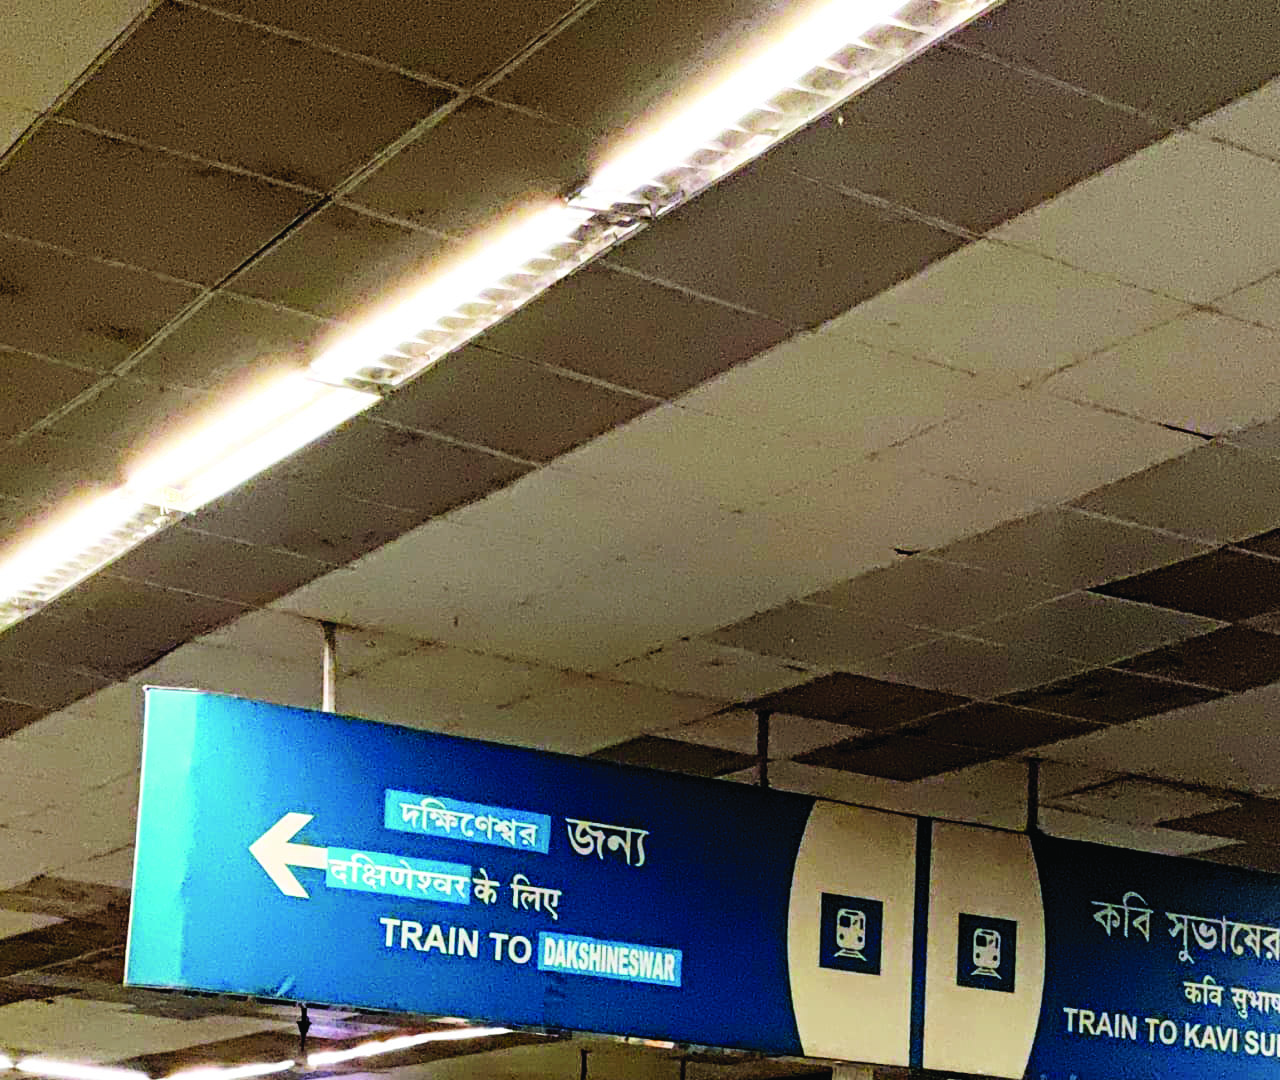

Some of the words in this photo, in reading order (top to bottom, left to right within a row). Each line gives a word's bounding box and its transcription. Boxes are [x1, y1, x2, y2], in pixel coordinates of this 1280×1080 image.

[397, 797, 538, 846] দক্ষিণেশ্বর
[565, 817, 650, 867] জন্য
[328, 853, 470, 898] दक्षिणेश्वर
[473, 867, 501, 905] के
[510, 873, 563, 920] लिए
[1091, 890, 1154, 942] কবি
[379, 917, 479, 958] TRAIN
[488, 931, 532, 964] TO
[544, 936, 676, 982] DAKSHINESWAR
[1182, 975, 1224, 1008] कवि
[1063, 1007, 1137, 1041] TRAIN
[1145, 1017, 1177, 1045] TO
[1184, 1022, 1238, 1053] KAVI
